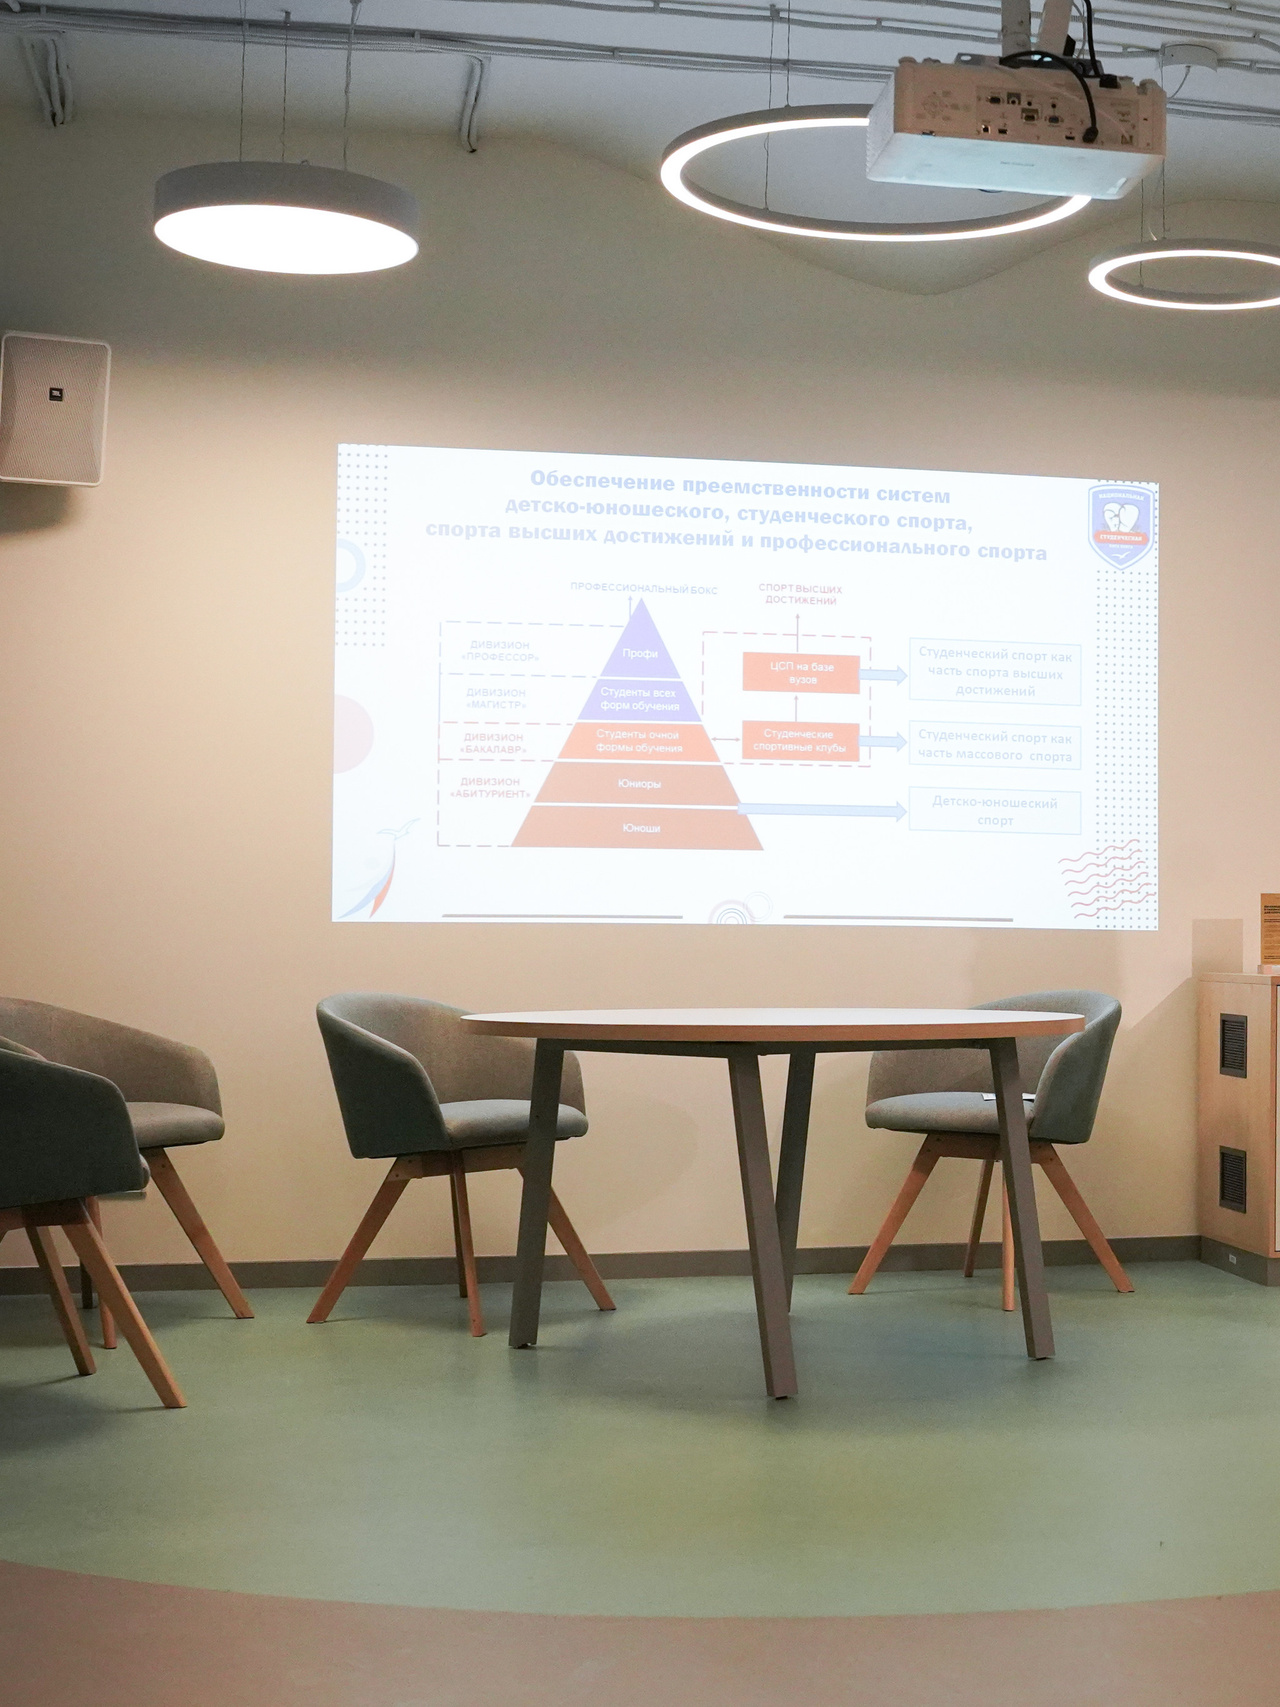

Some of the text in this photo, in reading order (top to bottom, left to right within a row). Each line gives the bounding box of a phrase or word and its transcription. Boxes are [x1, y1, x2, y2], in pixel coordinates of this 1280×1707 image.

[530, 470, 951, 505] Обеспечение преемственности систем
[505, 499, 973, 533] детско-юношеского, студенческого спорта,
[425, 523, 1047, 563] спорта высших достижений и профессионального спорта
[571, 581, 718, 595] ПРОФЕССИОНАЛЬНЫЙ БОКС
[759, 583, 842, 594] СПОРТ ВЫСШИХ
[765, 595, 837, 606] ДОСТИЖЕНИЙ
[470, 640, 530, 651] ДИВИЗИОН
[461, 652, 540, 663] «ПРОФЕССОР»
[623, 648, 659, 660] Профи
[919, 645, 1073, 664] Студенческий спорт как
[771, 661, 835, 673] ЦСП на базе
[928, 666, 1063, 680] часть спорта высших
[790, 675, 817, 684] вузов
[466, 688, 526, 699] ДИВИЗИОН
[601, 687, 676, 699] Студенты всех
[956, 683, 1036, 697] достижений
[466, 699, 527, 710] «МАГИСТР»
[601, 701, 680, 713] форм обучения
[464, 732, 524, 743] ДИВИЗИОН
[596, 729, 679, 741] Студенты очной
[764, 729, 834, 741] Студенческие
[918, 728, 1072, 747] Студенческий спорт как
[460, 744, 527, 755] «БАКАЛАВР»
[596, 743, 683, 755] формы обучения
[753, 742, 847, 754] спортивные клубы
[918, 749, 1073, 764] часть массового спорта
[461, 777, 520, 787] ДИВИЗИОН
[618, 779, 661, 790] Юниоры
[450, 789, 531, 799] «АБИТУРИЕНТ»
[933, 795, 1058, 810] Детско-юношеский
[978, 815, 1014, 826] спорт
[623, 824, 661, 833] Юноши
